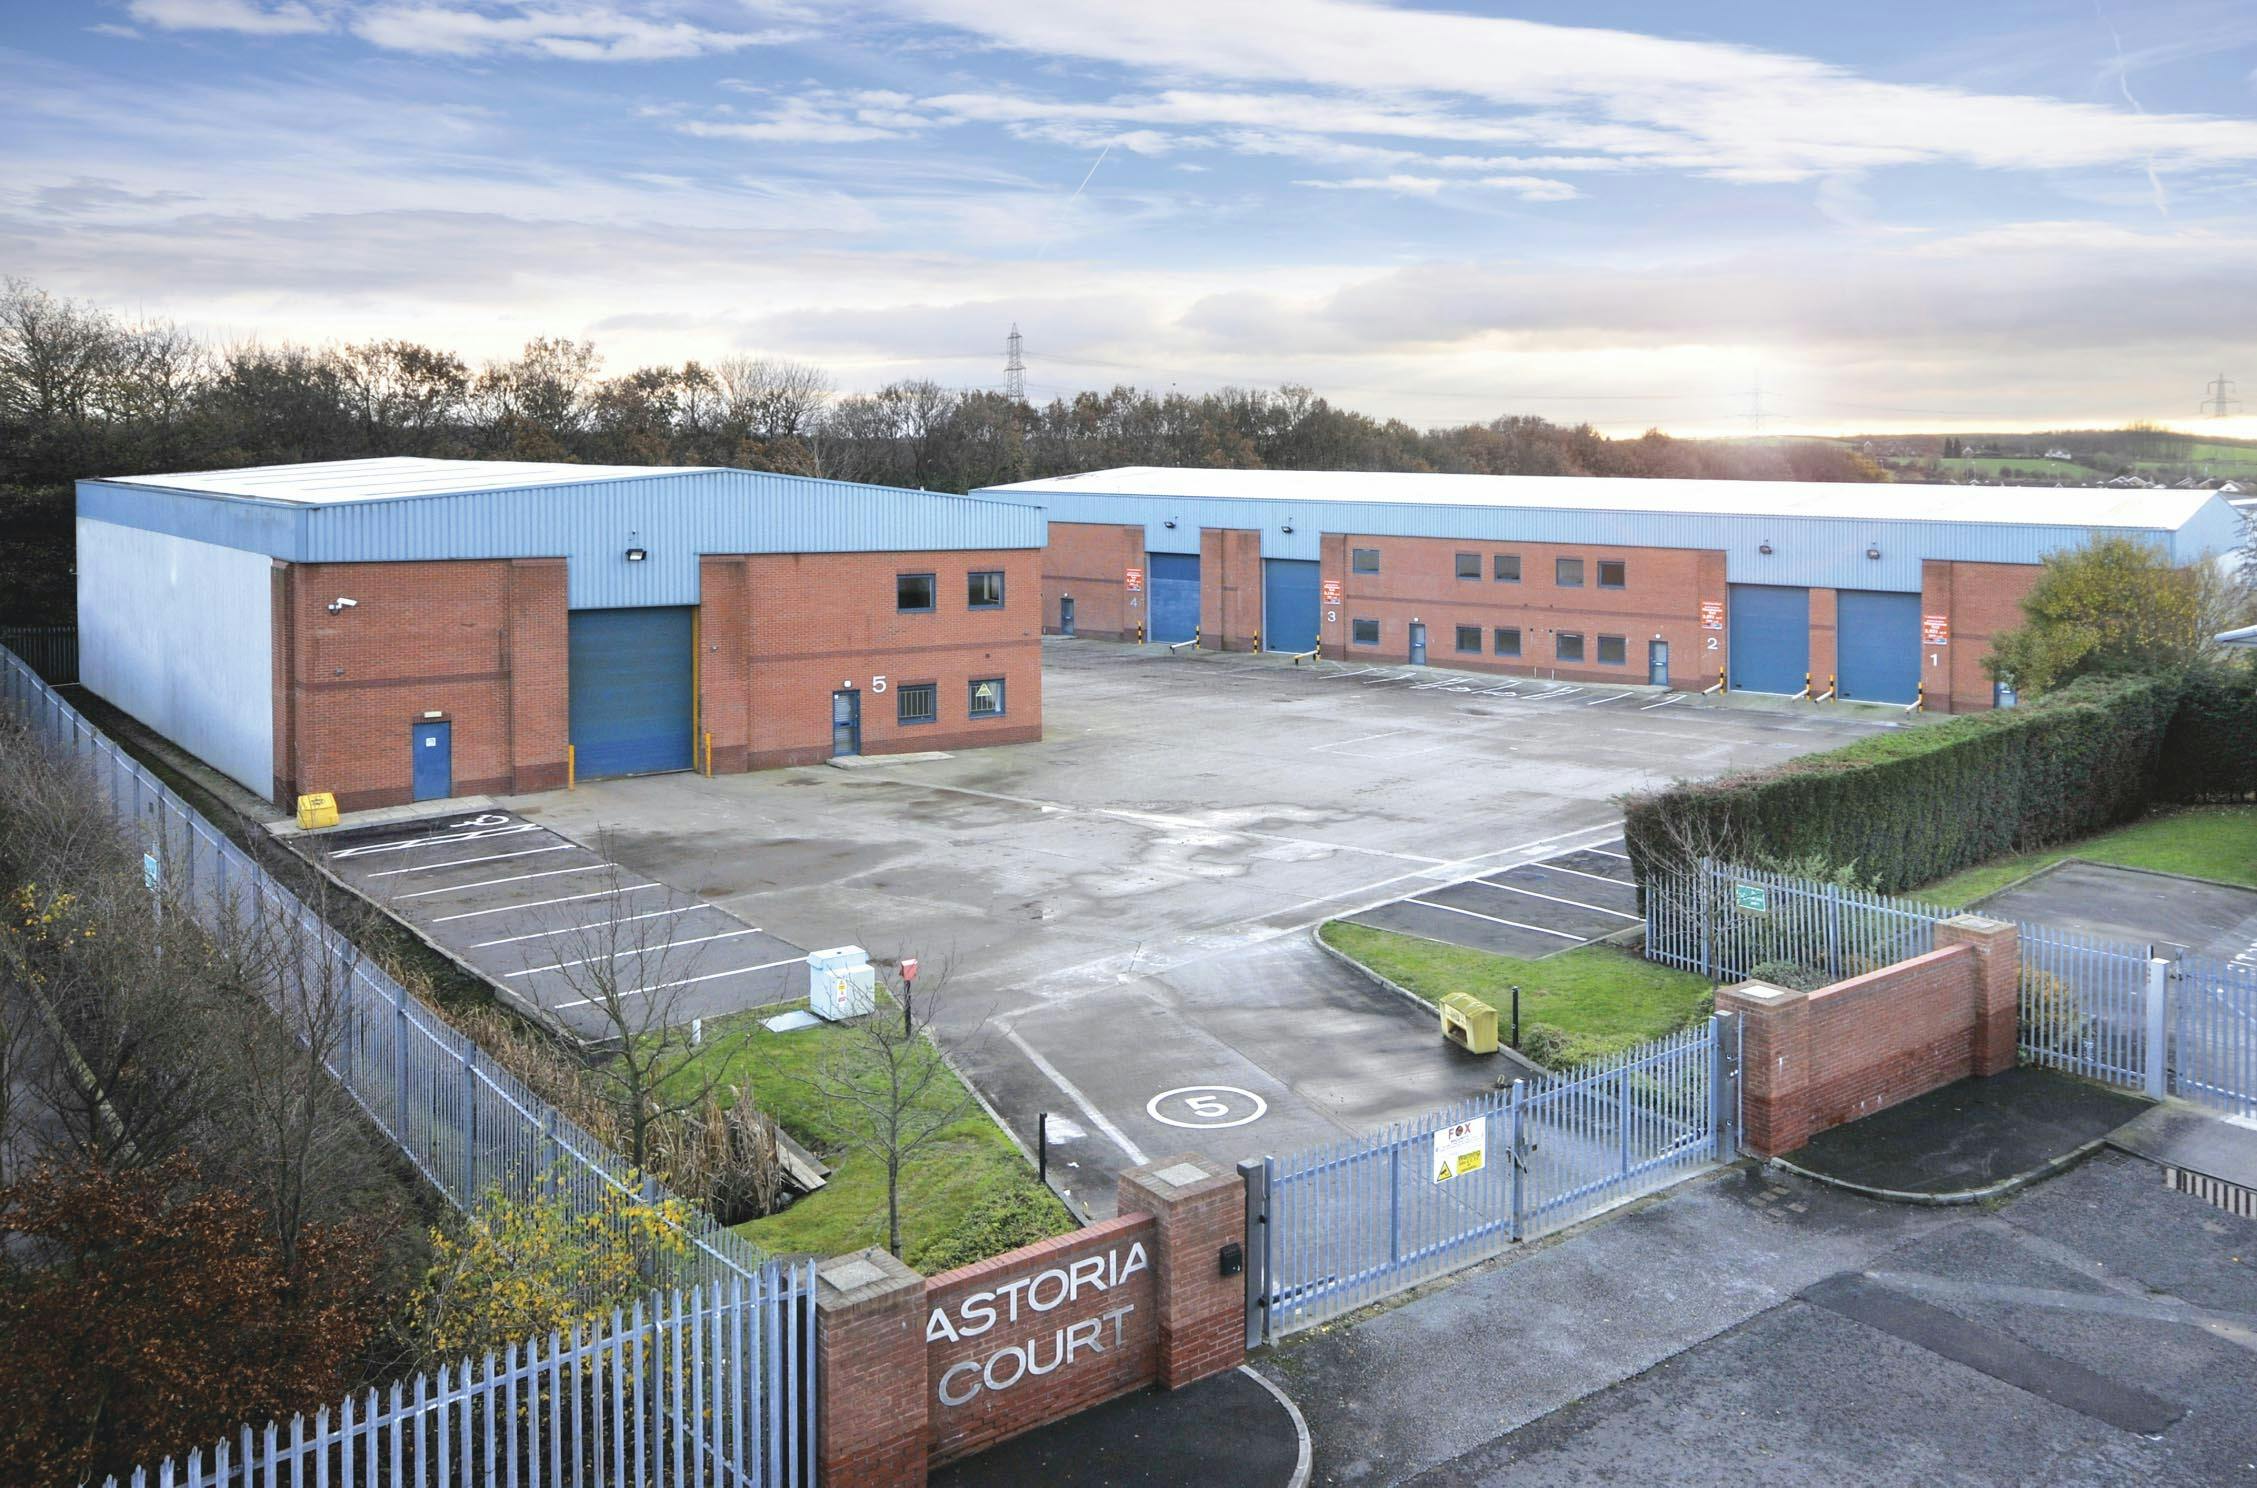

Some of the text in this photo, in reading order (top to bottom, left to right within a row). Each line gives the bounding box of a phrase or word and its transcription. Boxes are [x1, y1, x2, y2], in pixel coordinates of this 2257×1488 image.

[1327, 610, 1336, 622] 3
[1707, 637, 1718, 650] 2
[1930, 653, 1938, 667] 1
[872, 675, 887, 693] 5
[1184, 1095, 1229, 1117] 5
[1448, 1122, 1472, 1140] FOX
[926, 1241, 1148, 1343] ASTORIA
[938, 1304, 1135, 1407] COURT
